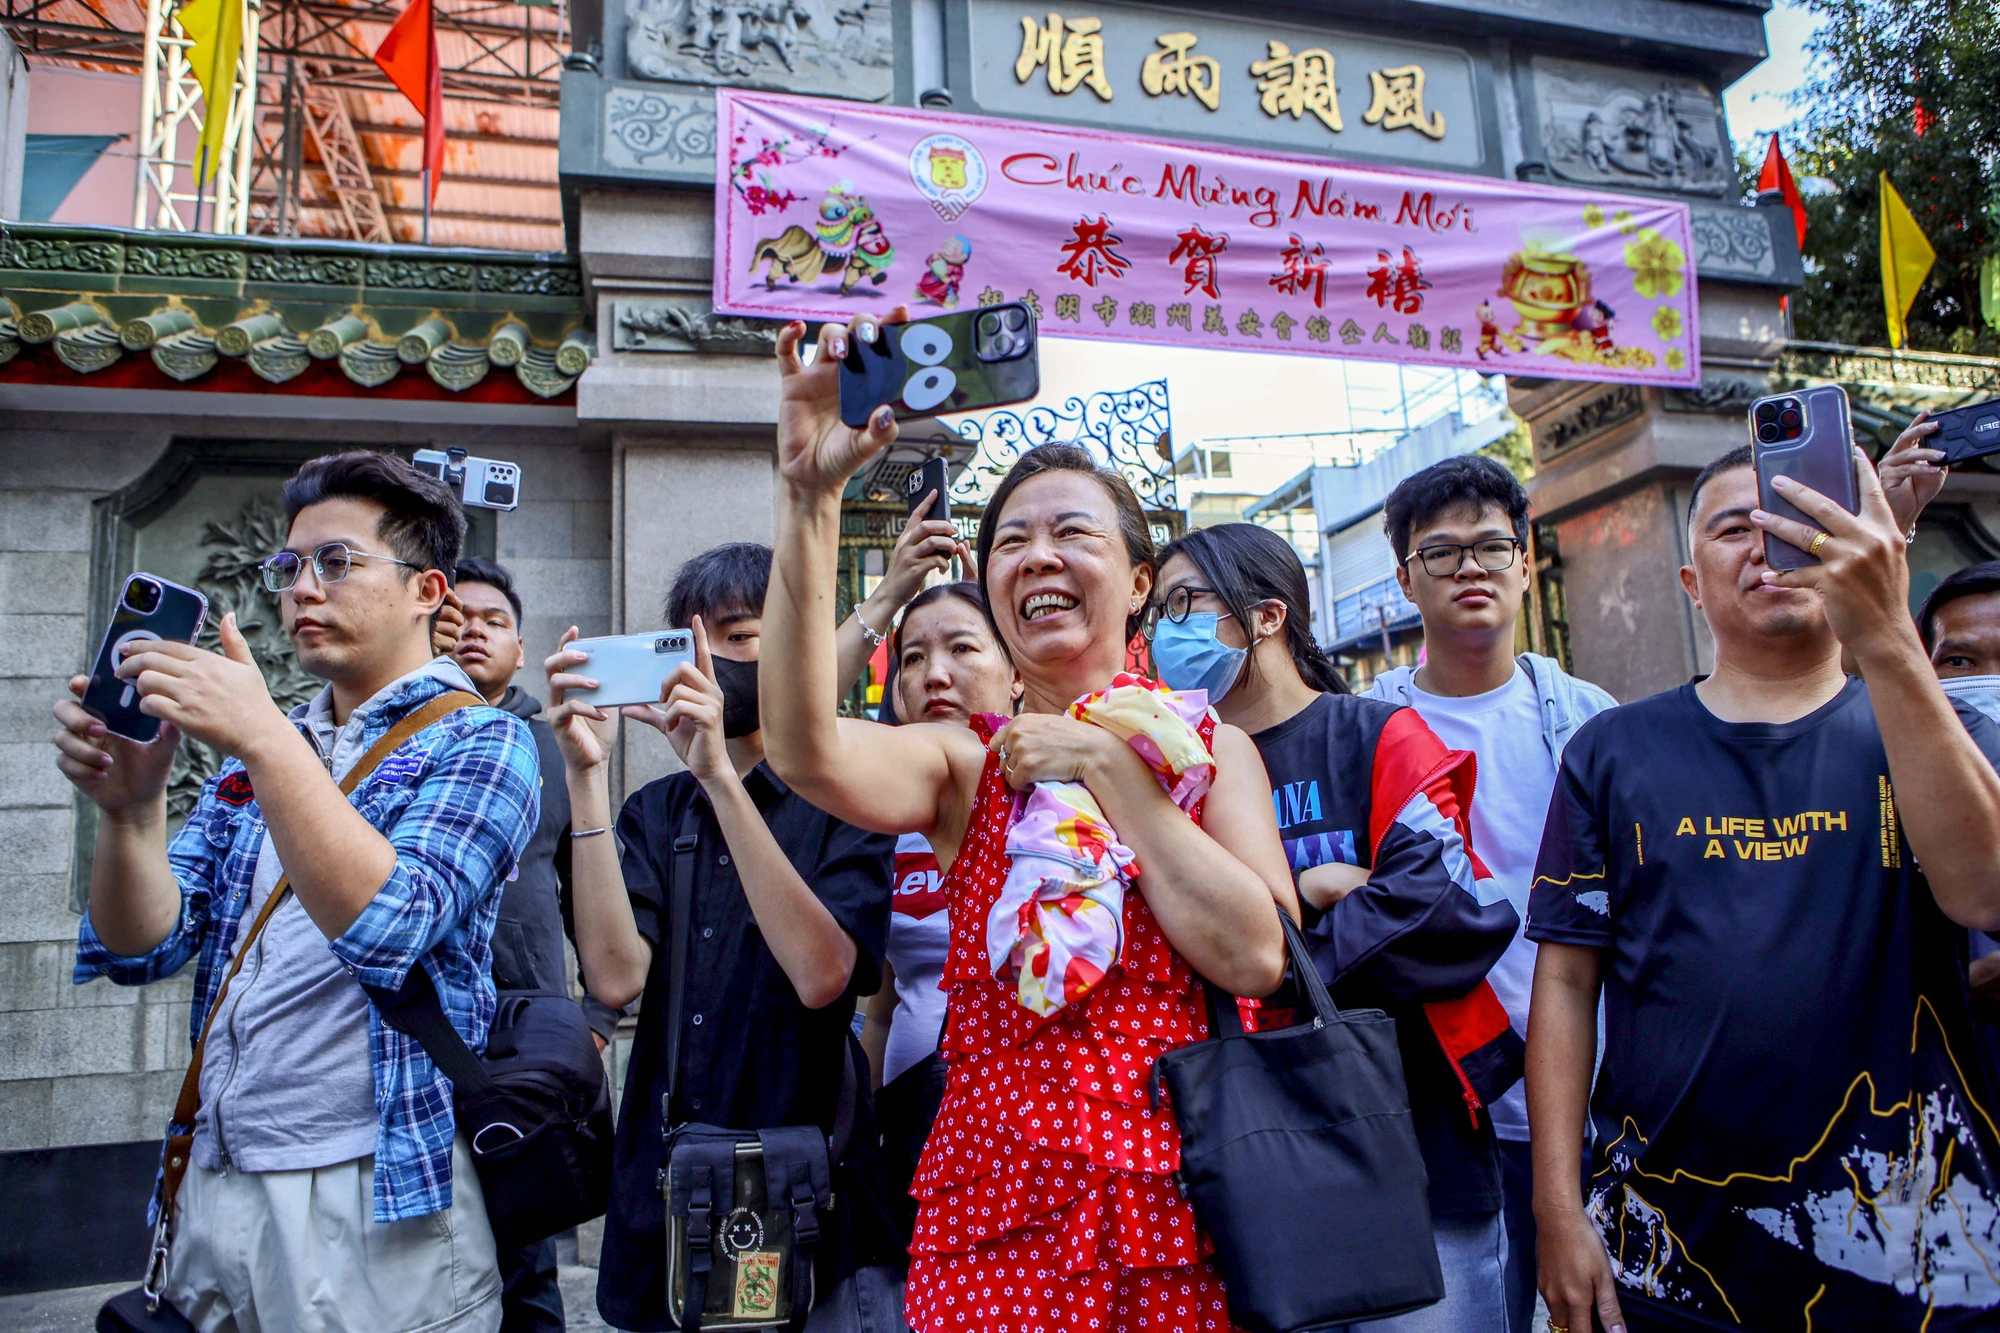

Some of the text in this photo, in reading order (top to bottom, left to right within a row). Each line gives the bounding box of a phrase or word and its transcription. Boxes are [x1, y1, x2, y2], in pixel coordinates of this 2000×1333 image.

[1001, 151, 1144, 195] Chúc
[1152, 163, 1283, 229] Mừng
[1289, 176, 1386, 223] Năm
[1392, 190, 1477, 235] Mới
[1056, 212, 1431, 315] 恭賀新禧
[1676, 811, 1848, 838] A LIFE WITH
[1703, 835, 1809, 862] A VIEW
